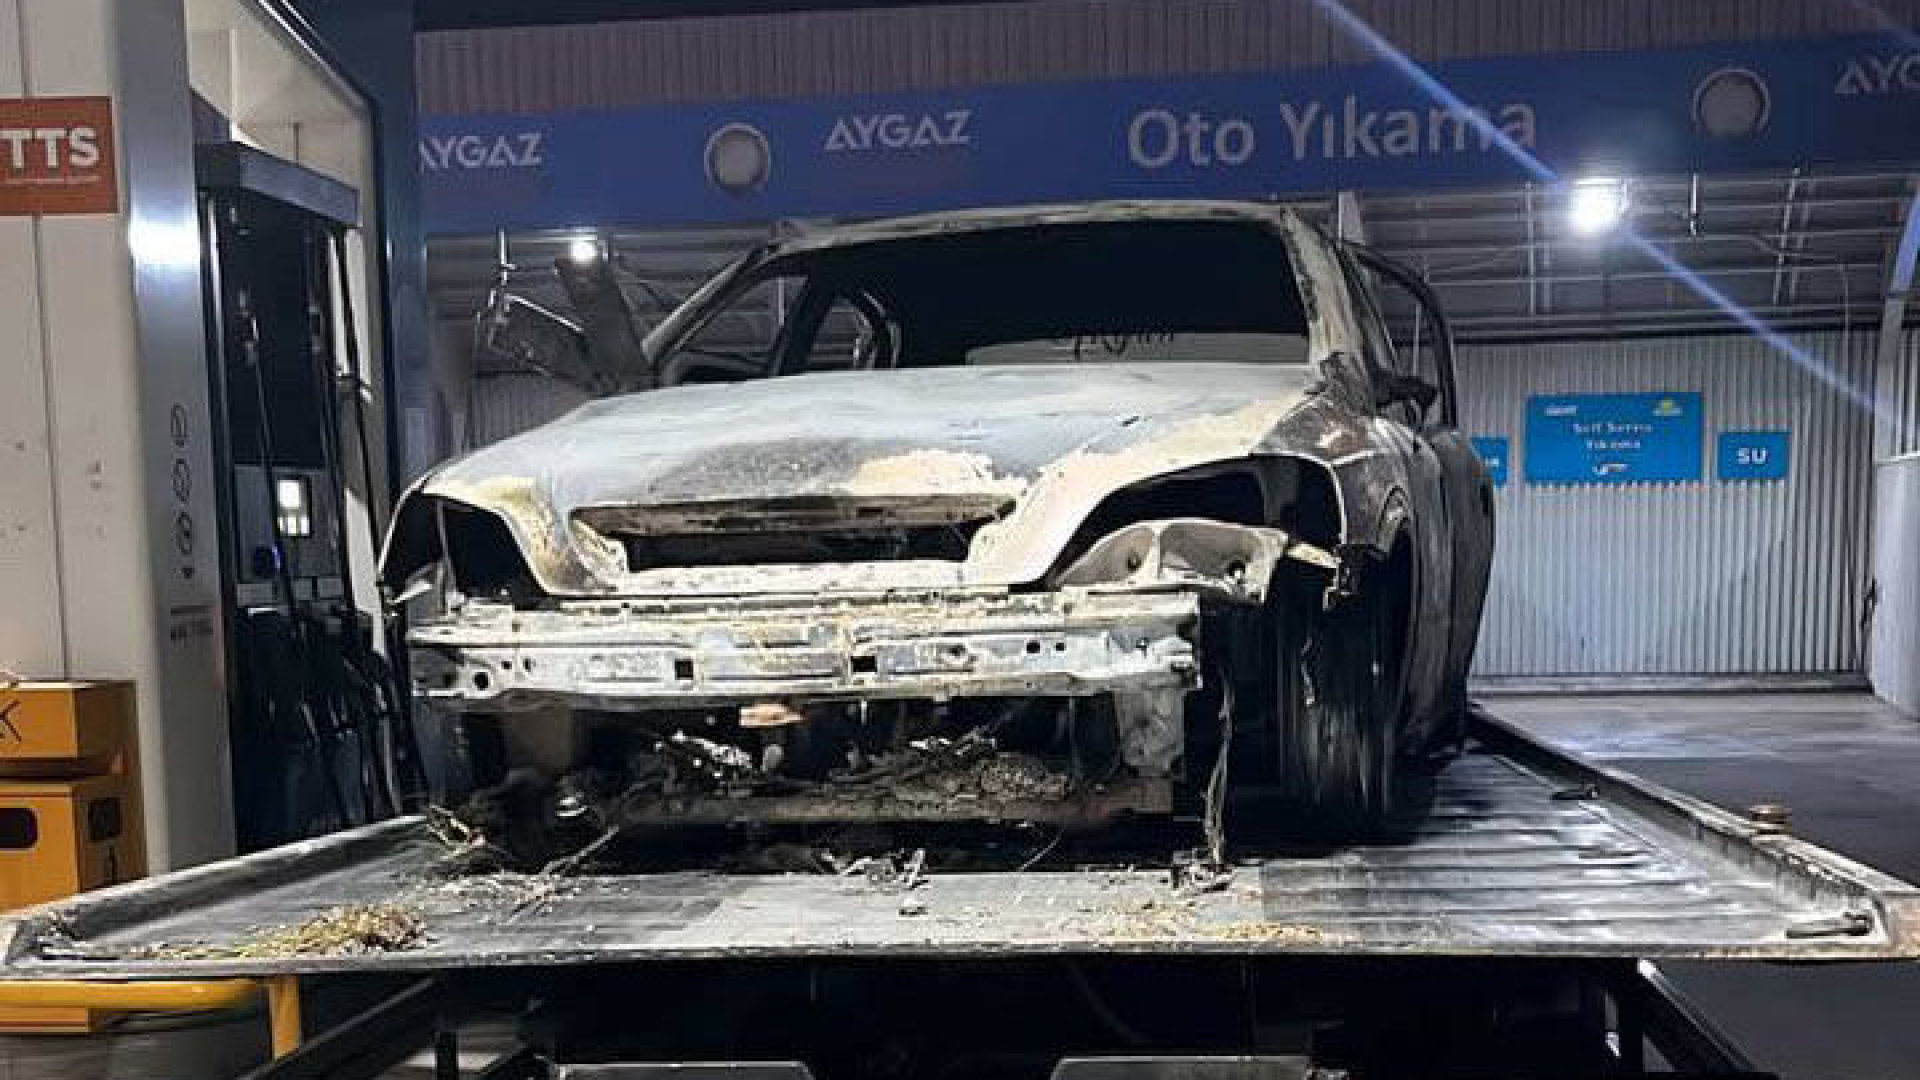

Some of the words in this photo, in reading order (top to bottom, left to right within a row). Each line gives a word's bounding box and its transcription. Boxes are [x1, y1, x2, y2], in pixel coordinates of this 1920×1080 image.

[0, 127, 100, 169] TTS
[824, 110, 972, 151] AYGAZ
[1128, 109, 1254, 168] Oto
[1280, 96, 1537, 159] Yıkama
[1735, 446, 1767, 466] SU
